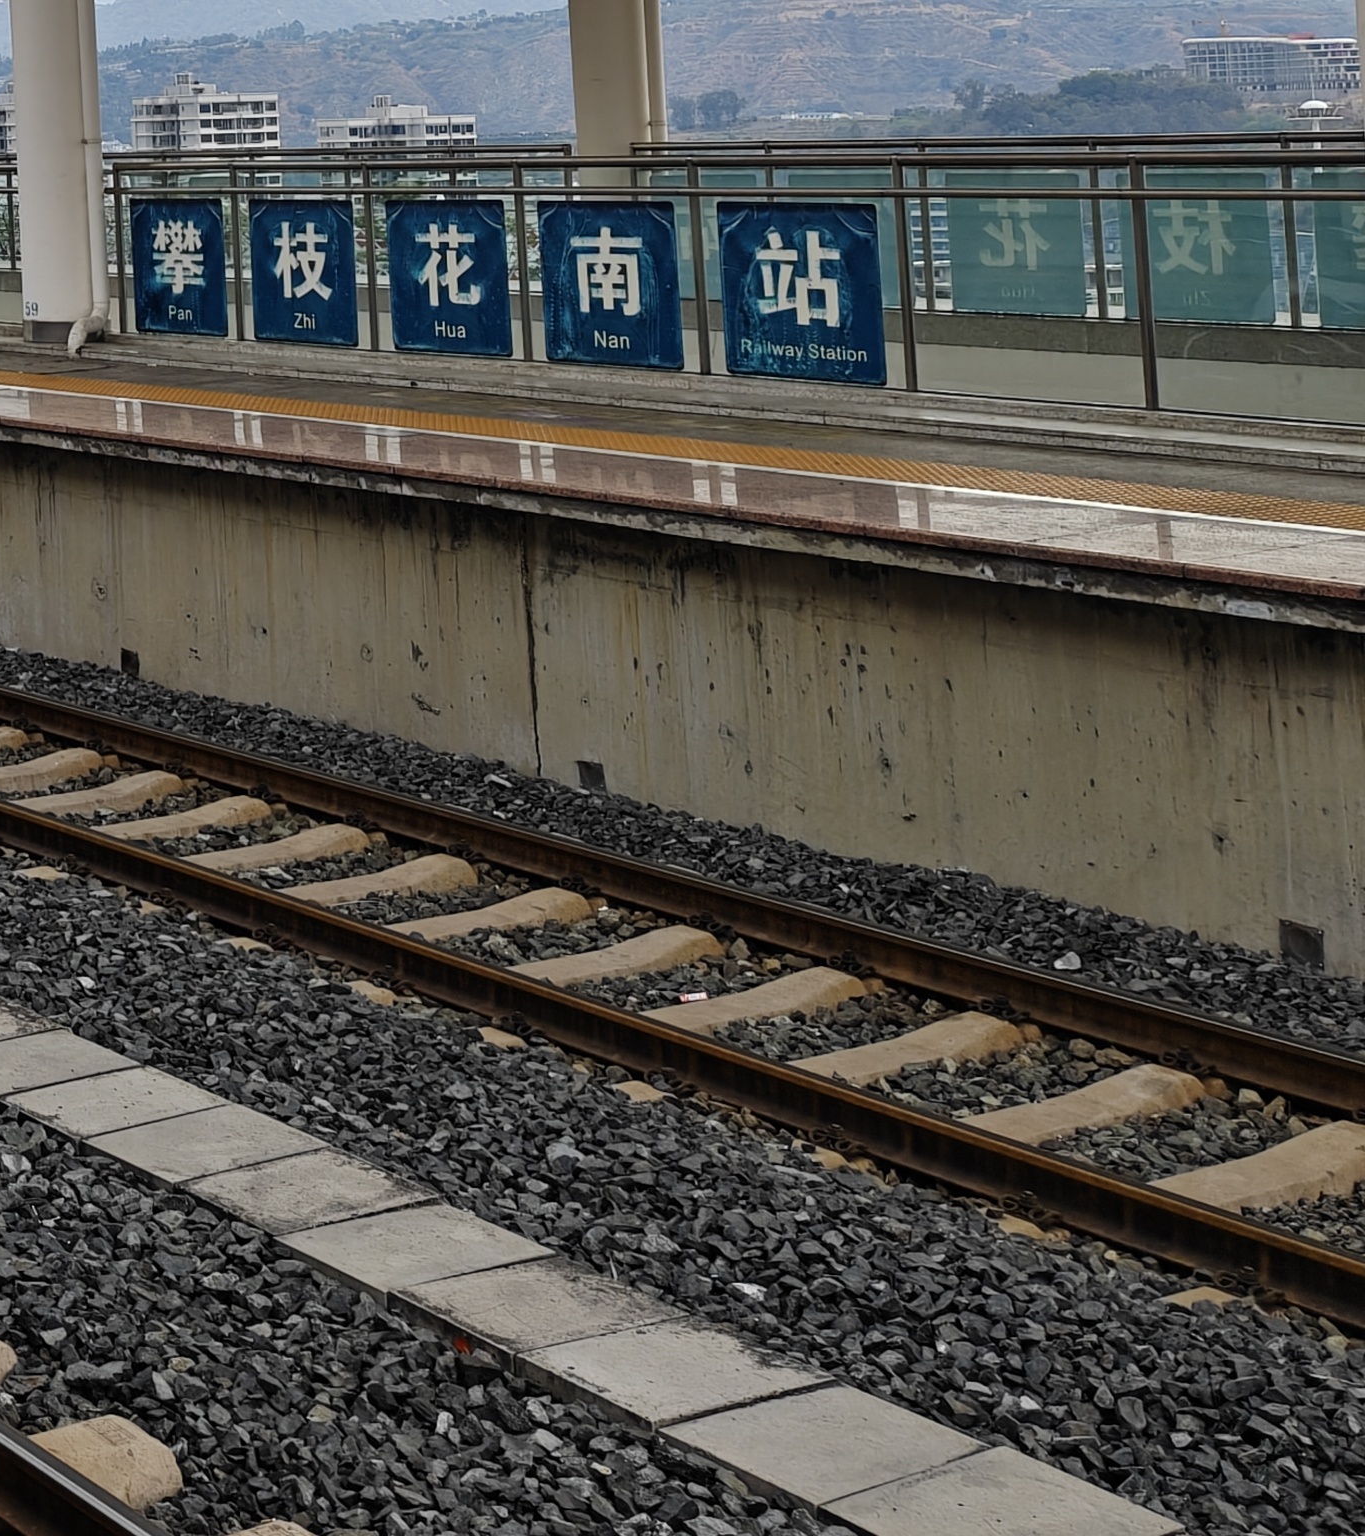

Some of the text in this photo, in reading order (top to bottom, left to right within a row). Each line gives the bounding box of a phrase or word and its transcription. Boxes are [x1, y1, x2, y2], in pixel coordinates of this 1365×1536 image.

[272, 221, 334, 302] 枝
[414, 222, 481, 307] 花
[570, 225, 643, 317] 南
[755, 225, 841, 328] 站
[25, 301, 39, 317] 59
[168, 304, 631, 350] Pan Zhi Hua Nan
[740, 338, 868, 363] Railway Station
